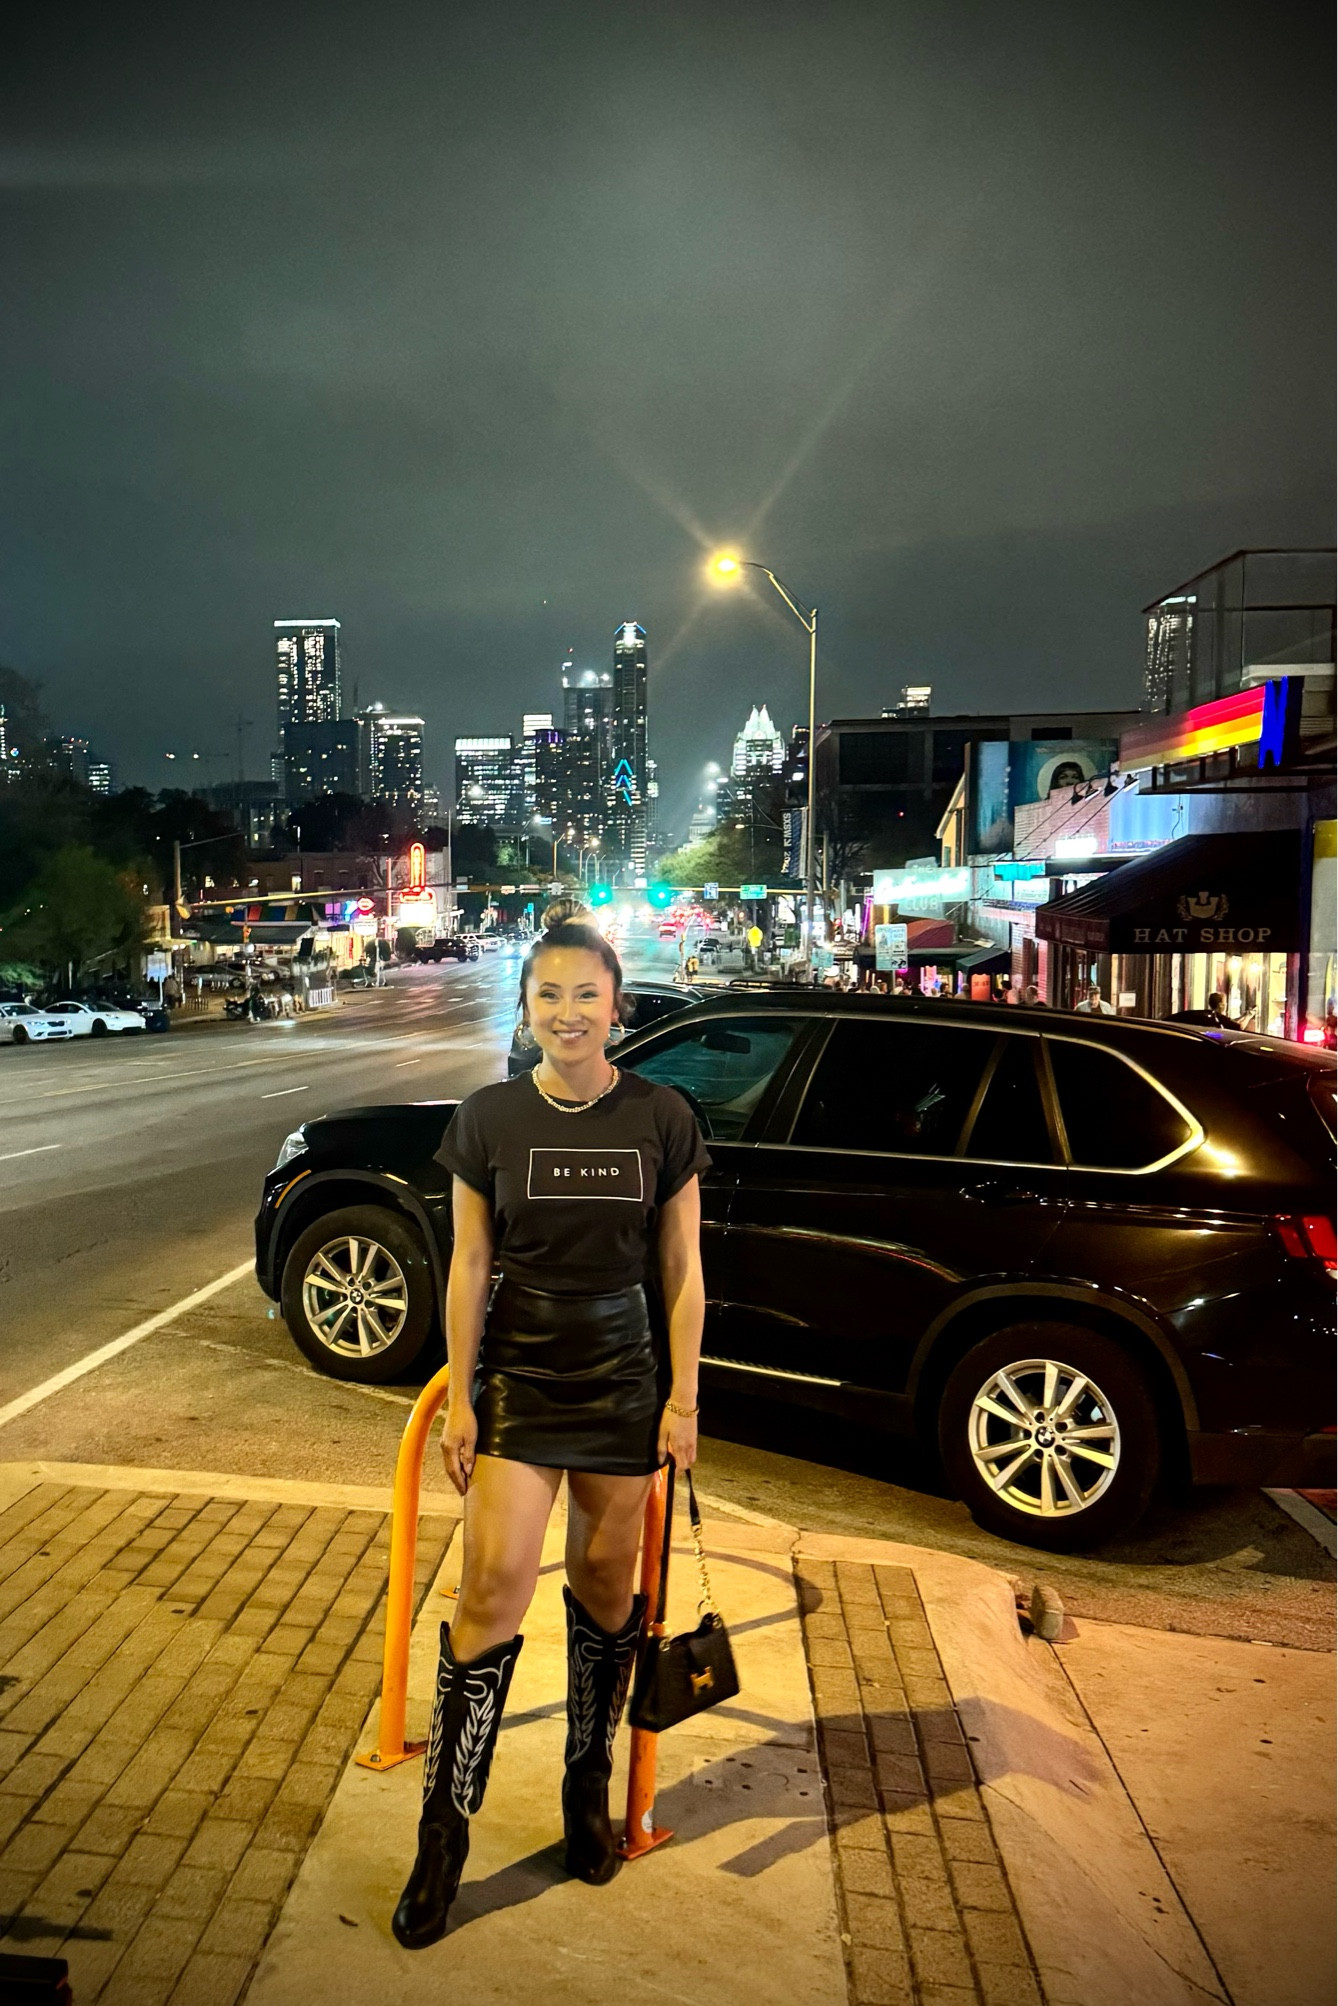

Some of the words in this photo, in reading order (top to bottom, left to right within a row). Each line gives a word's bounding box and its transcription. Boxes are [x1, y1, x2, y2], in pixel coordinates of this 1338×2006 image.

[906, 897, 937, 911] CLUB
[1134, 928, 1188, 943] HAT
[1200, 927, 1272, 943] SHOP
[553, 1167, 571, 1177] BE
[580, 1167, 620, 1177] KIND
